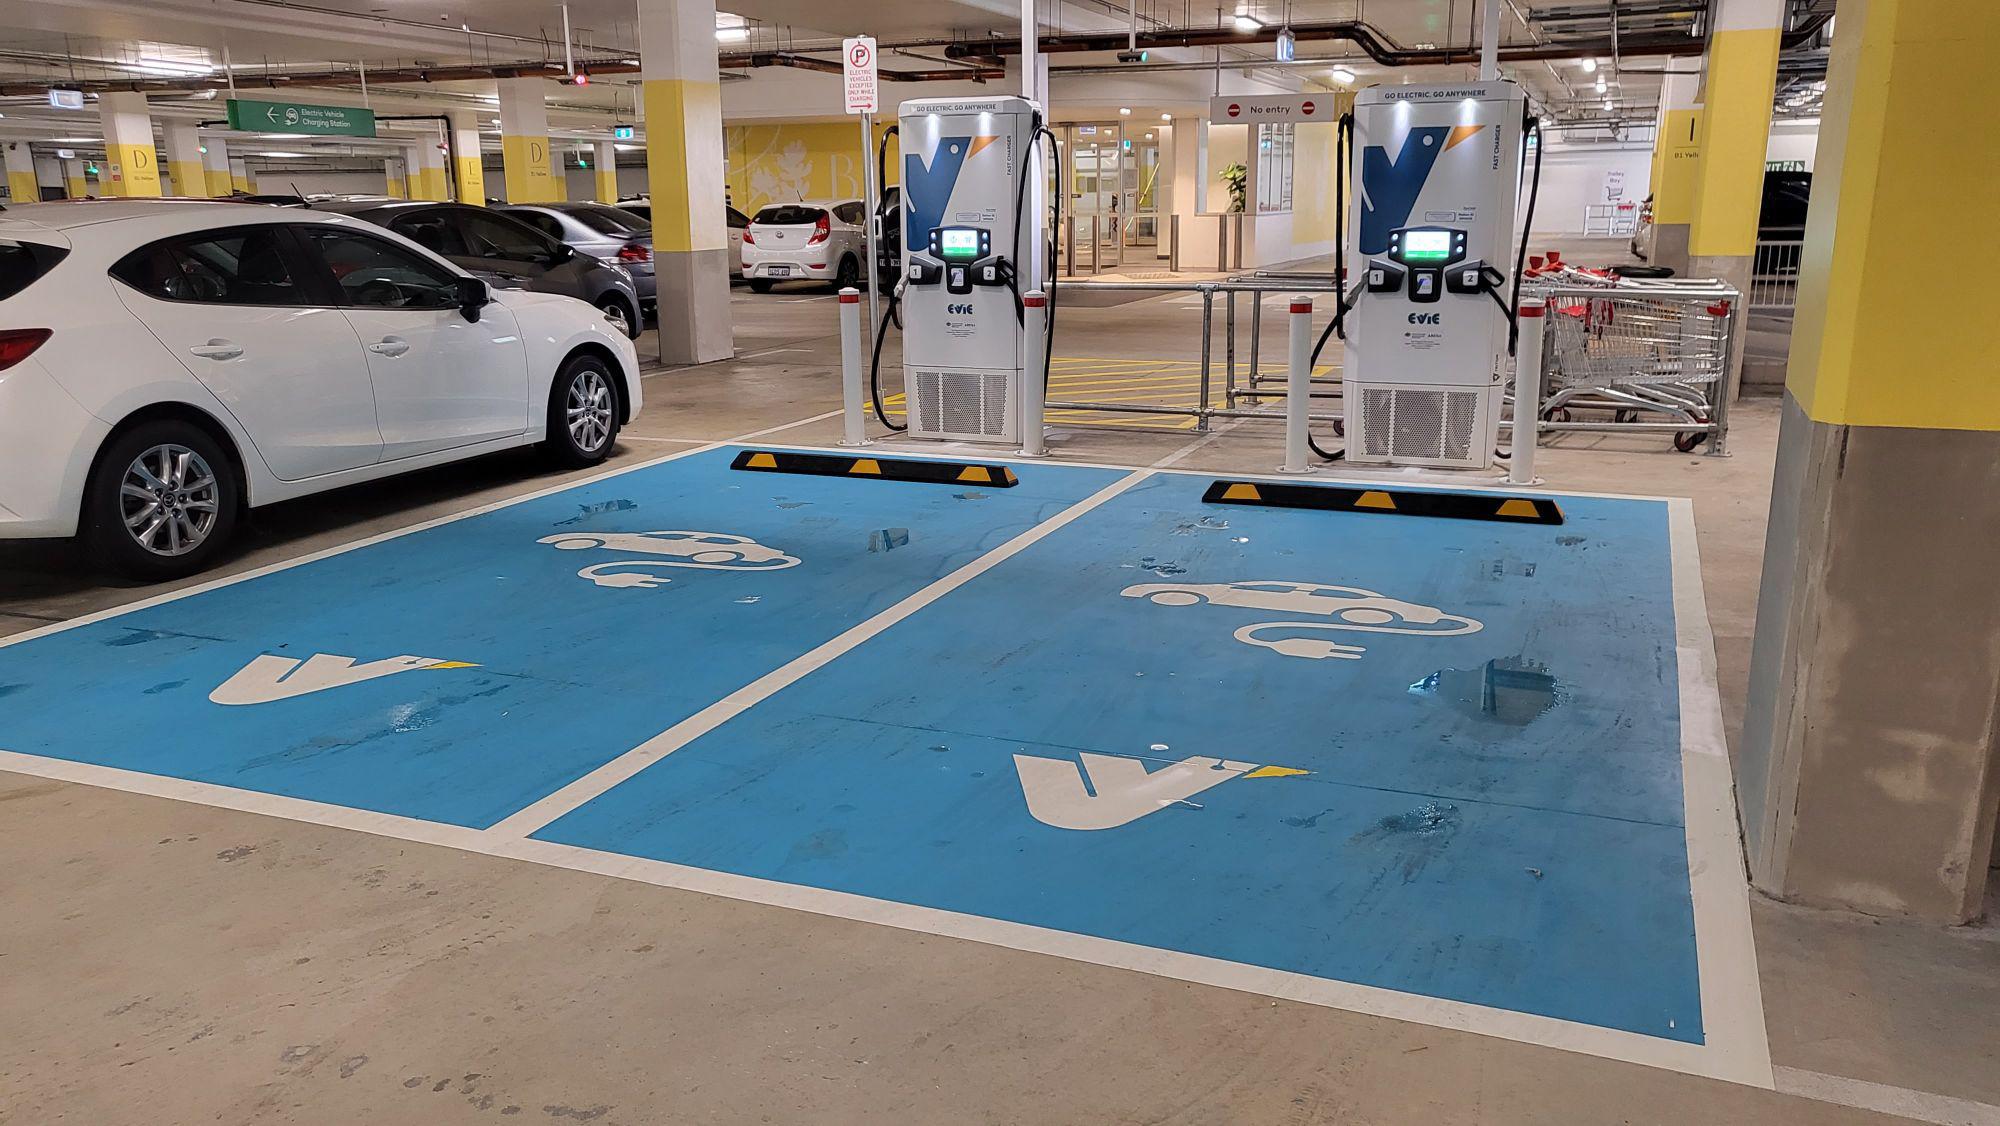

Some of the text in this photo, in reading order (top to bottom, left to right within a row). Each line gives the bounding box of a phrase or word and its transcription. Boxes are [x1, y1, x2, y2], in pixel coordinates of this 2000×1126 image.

[1445, 89, 1486, 97] ANYWHERE
[964, 103, 997, 111] ANYWHERE
[1250, 105, 1291, 115] No entry
[301, 108, 345, 118] Electric Vehicle
[302, 118, 351, 128] Charging Station
[530, 142, 542, 163] D
[133, 149, 147, 169] D
[913, 268, 918, 276] 1
[1374, 273, 1379, 281] 1
[1467, 274, 1474, 283] 2
